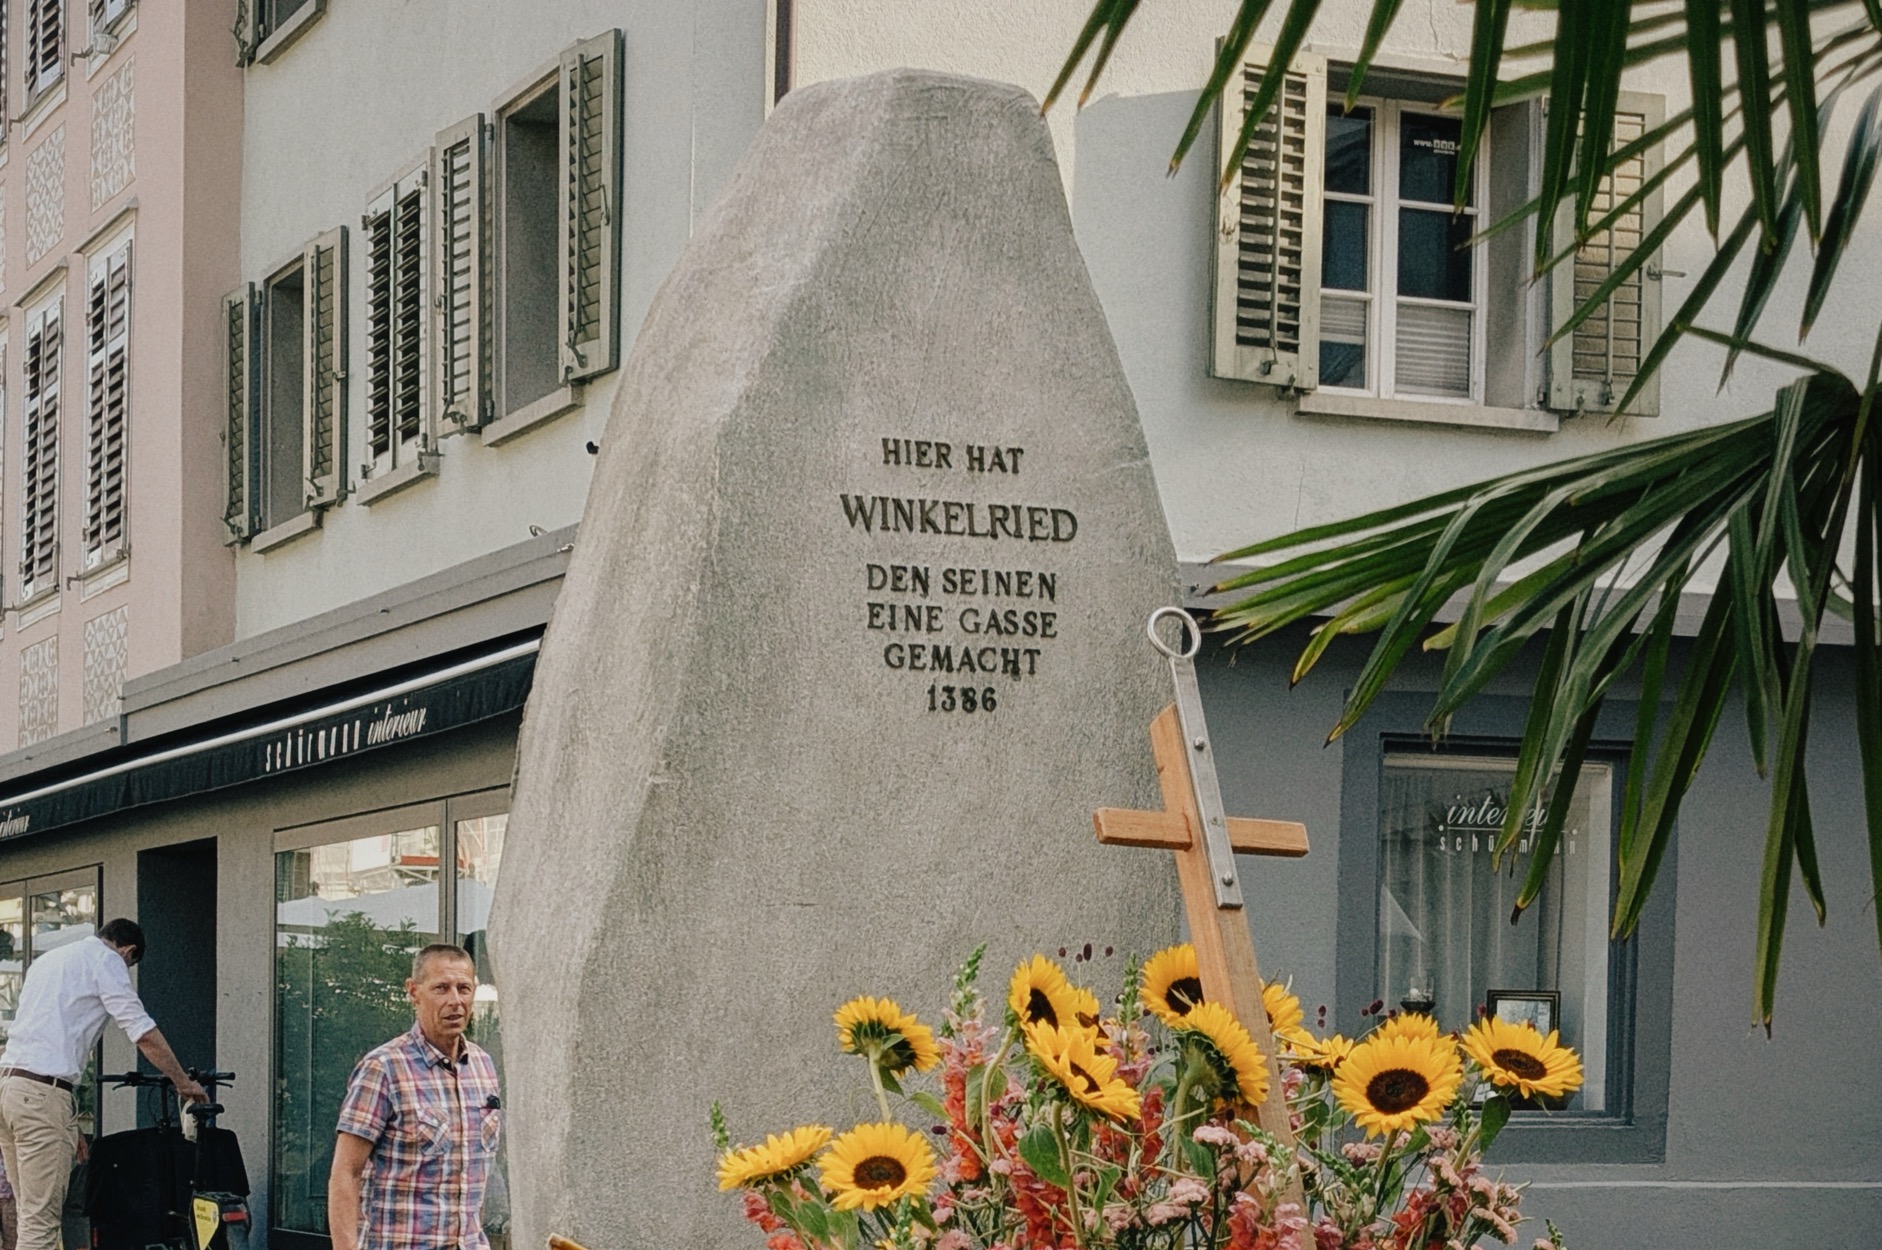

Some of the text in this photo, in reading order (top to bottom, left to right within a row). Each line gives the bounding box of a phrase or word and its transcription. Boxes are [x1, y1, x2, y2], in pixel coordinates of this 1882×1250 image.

[881, 438, 1024, 474] HIER HAT
[839, 493, 1079, 543] WINKELRIED
[866, 563, 1057, 602] DEN SEINEN
[867, 602, 1058, 638] EINE GASSE
[884, 643, 1041, 676] GEMACHT
[927, 684, 998, 713] 1386
[367, 698, 427, 745] interieur
